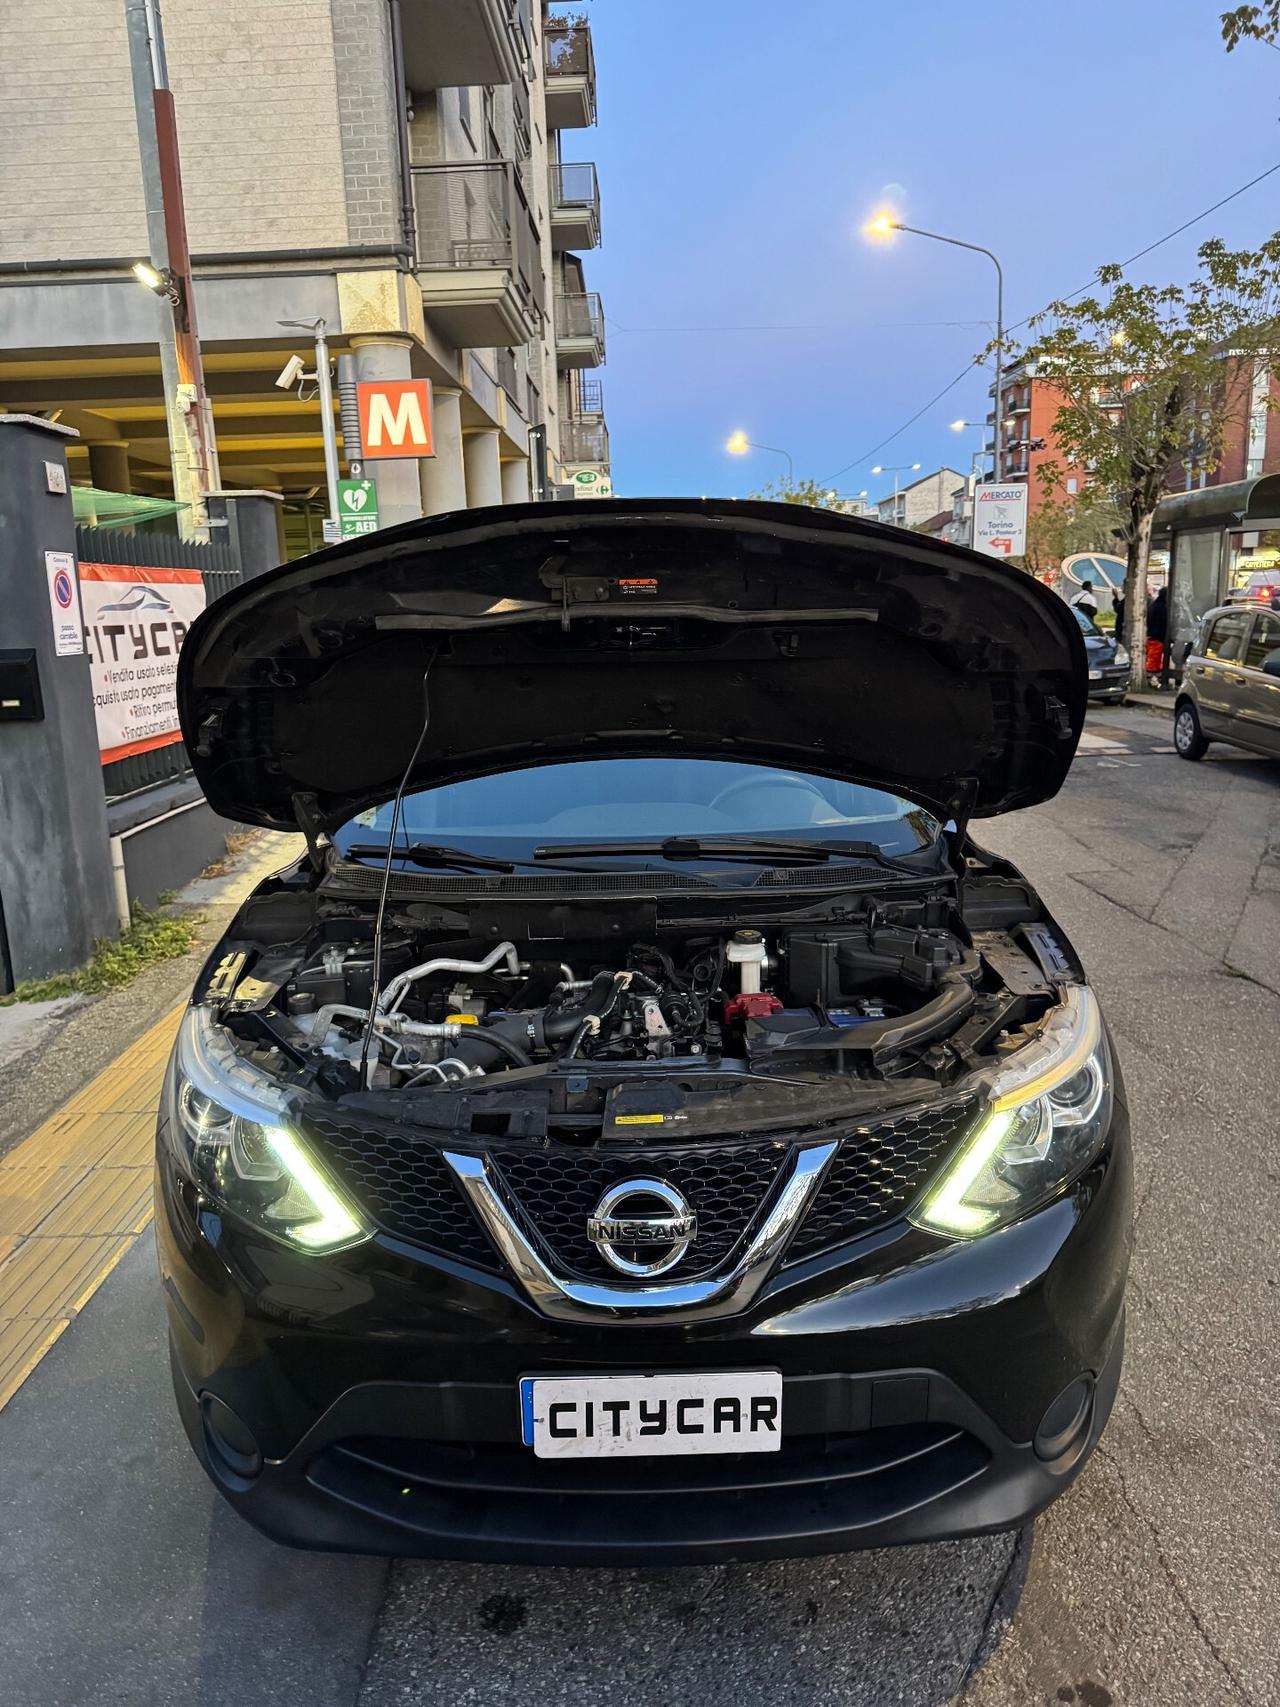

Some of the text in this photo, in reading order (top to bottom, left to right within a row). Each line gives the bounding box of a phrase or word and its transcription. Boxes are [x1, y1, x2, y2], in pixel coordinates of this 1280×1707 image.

[367, 392, 427, 447] M
[355, 520, 377, 533] AED
[987, 520, 1014, 529] Torino
[107, 667, 134, 683] Vendita
[136, 665, 155, 680] usato
[598, 1223, 686, 1241] NISSAN
[548, 1396, 778, 1440] CITYCAR
